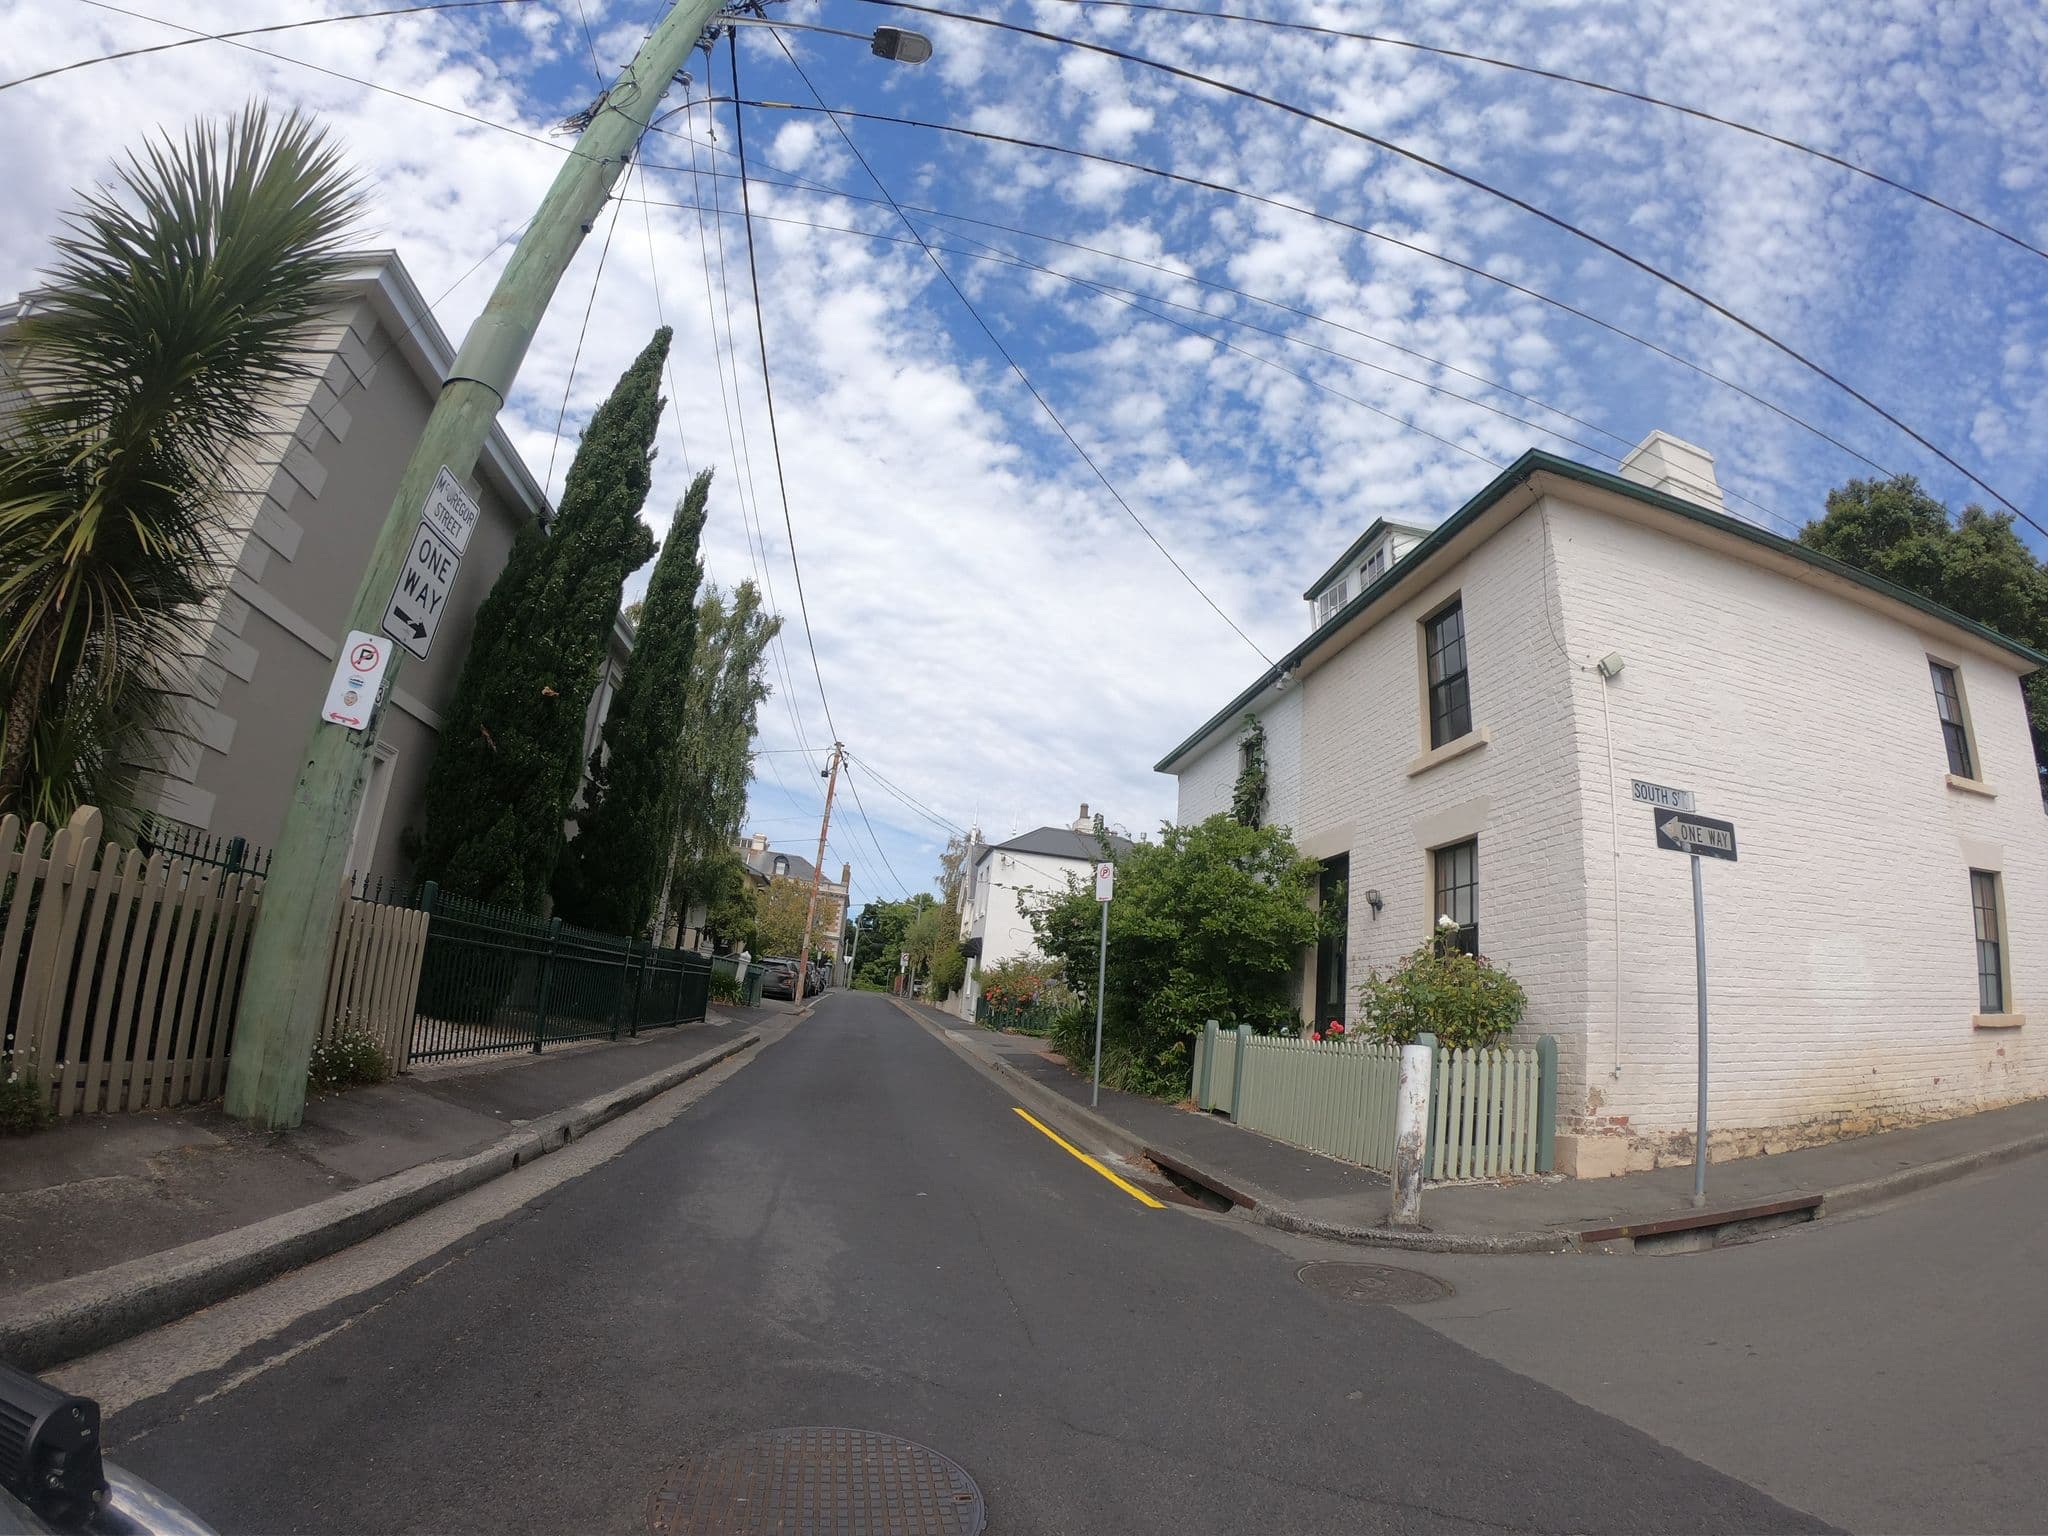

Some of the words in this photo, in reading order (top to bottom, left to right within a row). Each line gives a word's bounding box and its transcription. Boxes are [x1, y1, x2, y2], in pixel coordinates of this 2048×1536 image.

[434, 502, 462, 539] STREET
[419, 539, 452, 585] ONE
[403, 567, 442, 615] WAY
[1634, 783, 1669, 805] SOUTH
[1681, 824, 1703, 843] ONE
[1708, 830, 1728, 849] WAY
